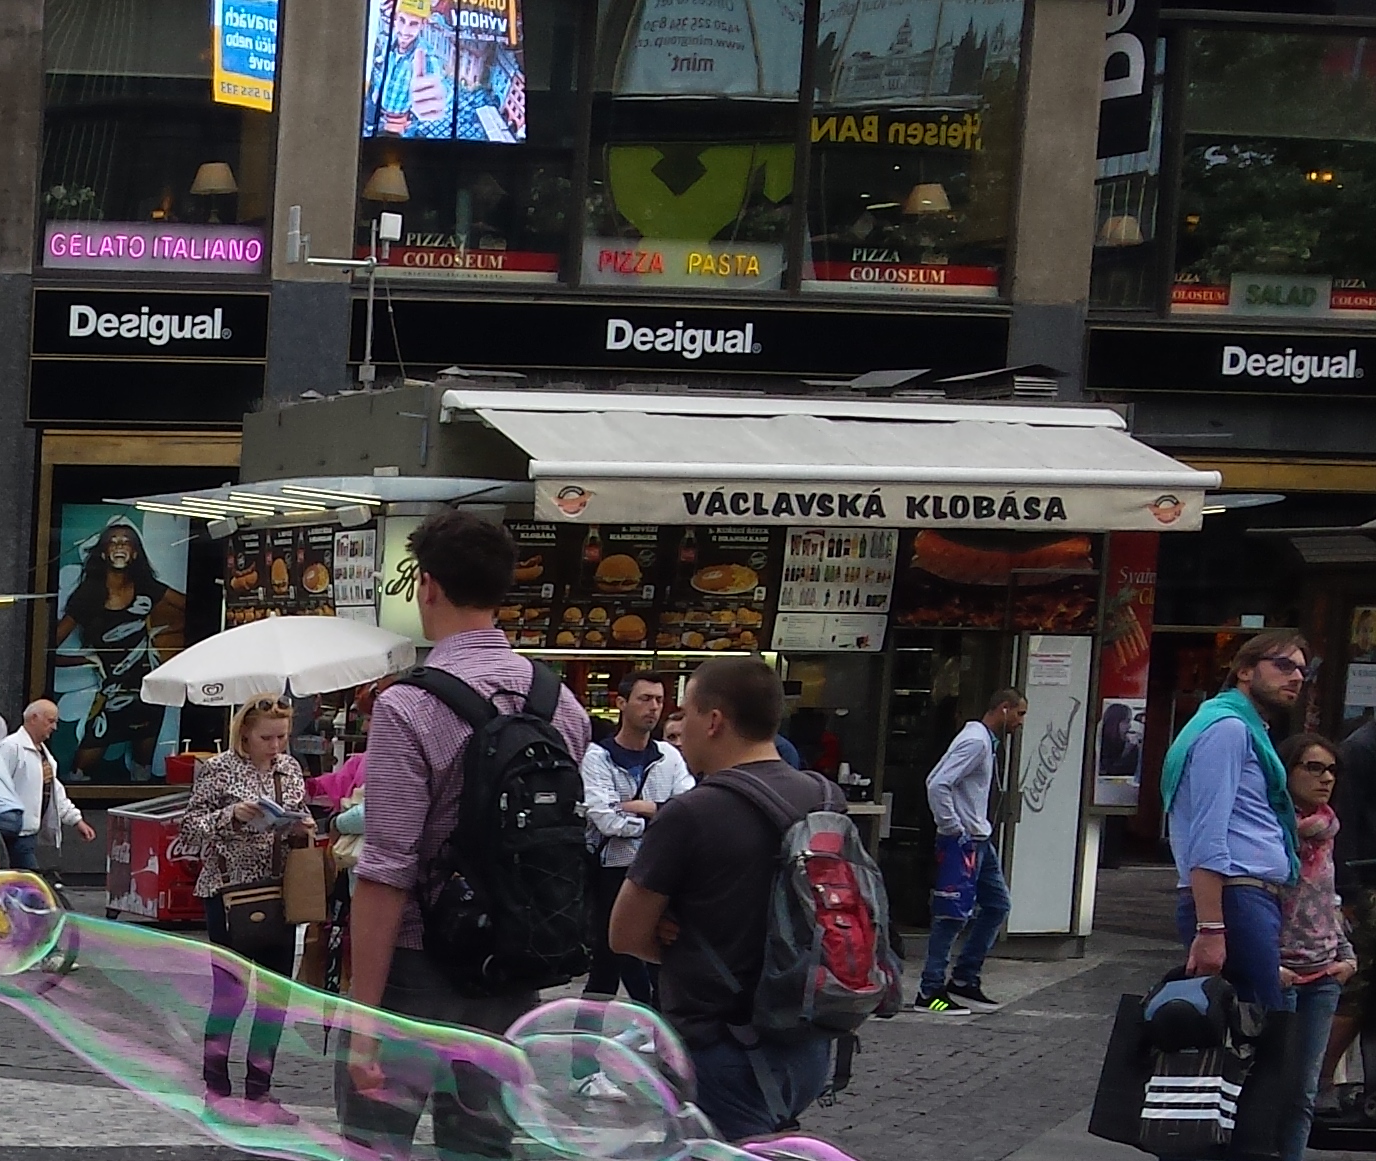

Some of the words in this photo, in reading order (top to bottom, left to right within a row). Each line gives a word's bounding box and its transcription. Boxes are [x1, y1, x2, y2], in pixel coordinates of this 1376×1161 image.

[51, 232, 146, 258] GELATO
[152, 235, 262, 262] ITALIANO
[405, 232, 457, 249] PIZZA
[402, 250, 503, 270] COLOSEUM
[598, 250, 664, 274] PIZZA
[687, 252, 760, 276] PASTA
[851, 248, 900, 263] PIZZA
[849, 266, 946, 284] COLOSEUM
[1246, 284, 1317, 308] SALAD
[68, 304, 223, 346] Desigual
[605, 318, 753, 360] Desigual
[1221, 345, 1357, 384] Desigual
[683, 485, 886, 519] VÁCLAVSKÁ
[905, 490, 1067, 521] KLOBÁSA
